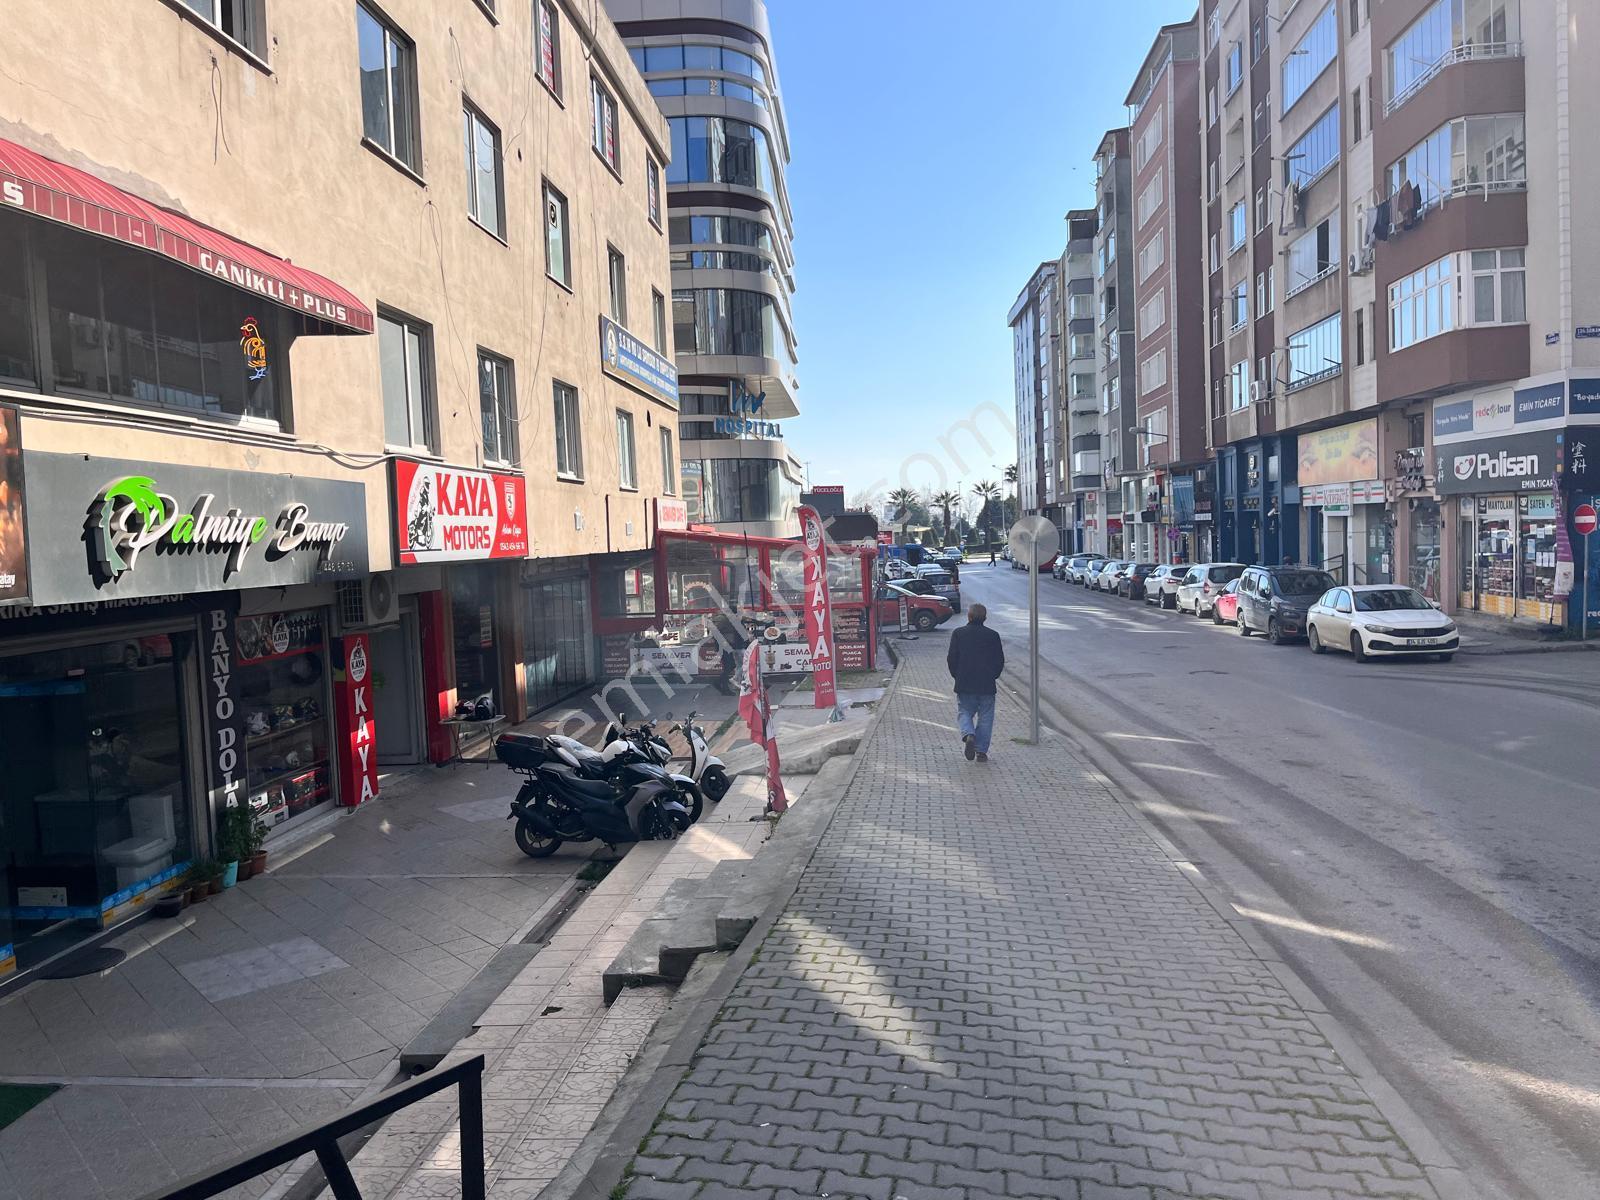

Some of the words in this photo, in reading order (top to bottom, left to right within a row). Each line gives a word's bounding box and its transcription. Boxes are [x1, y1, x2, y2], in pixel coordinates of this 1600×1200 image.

[303, 293, 347, 322] PLUS
[714, 417, 784, 439] HOSPITAL
[1477, 451, 1539, 479] Polisan
[435, 472, 494, 517] KAYA
[277, 503, 349, 561] Banyo
[443, 525, 491, 551] MOTORS
[210, 609, 236, 720] BANYO
[350, 659, 366, 671] KAYA
[354, 687, 374, 803] KAYA
